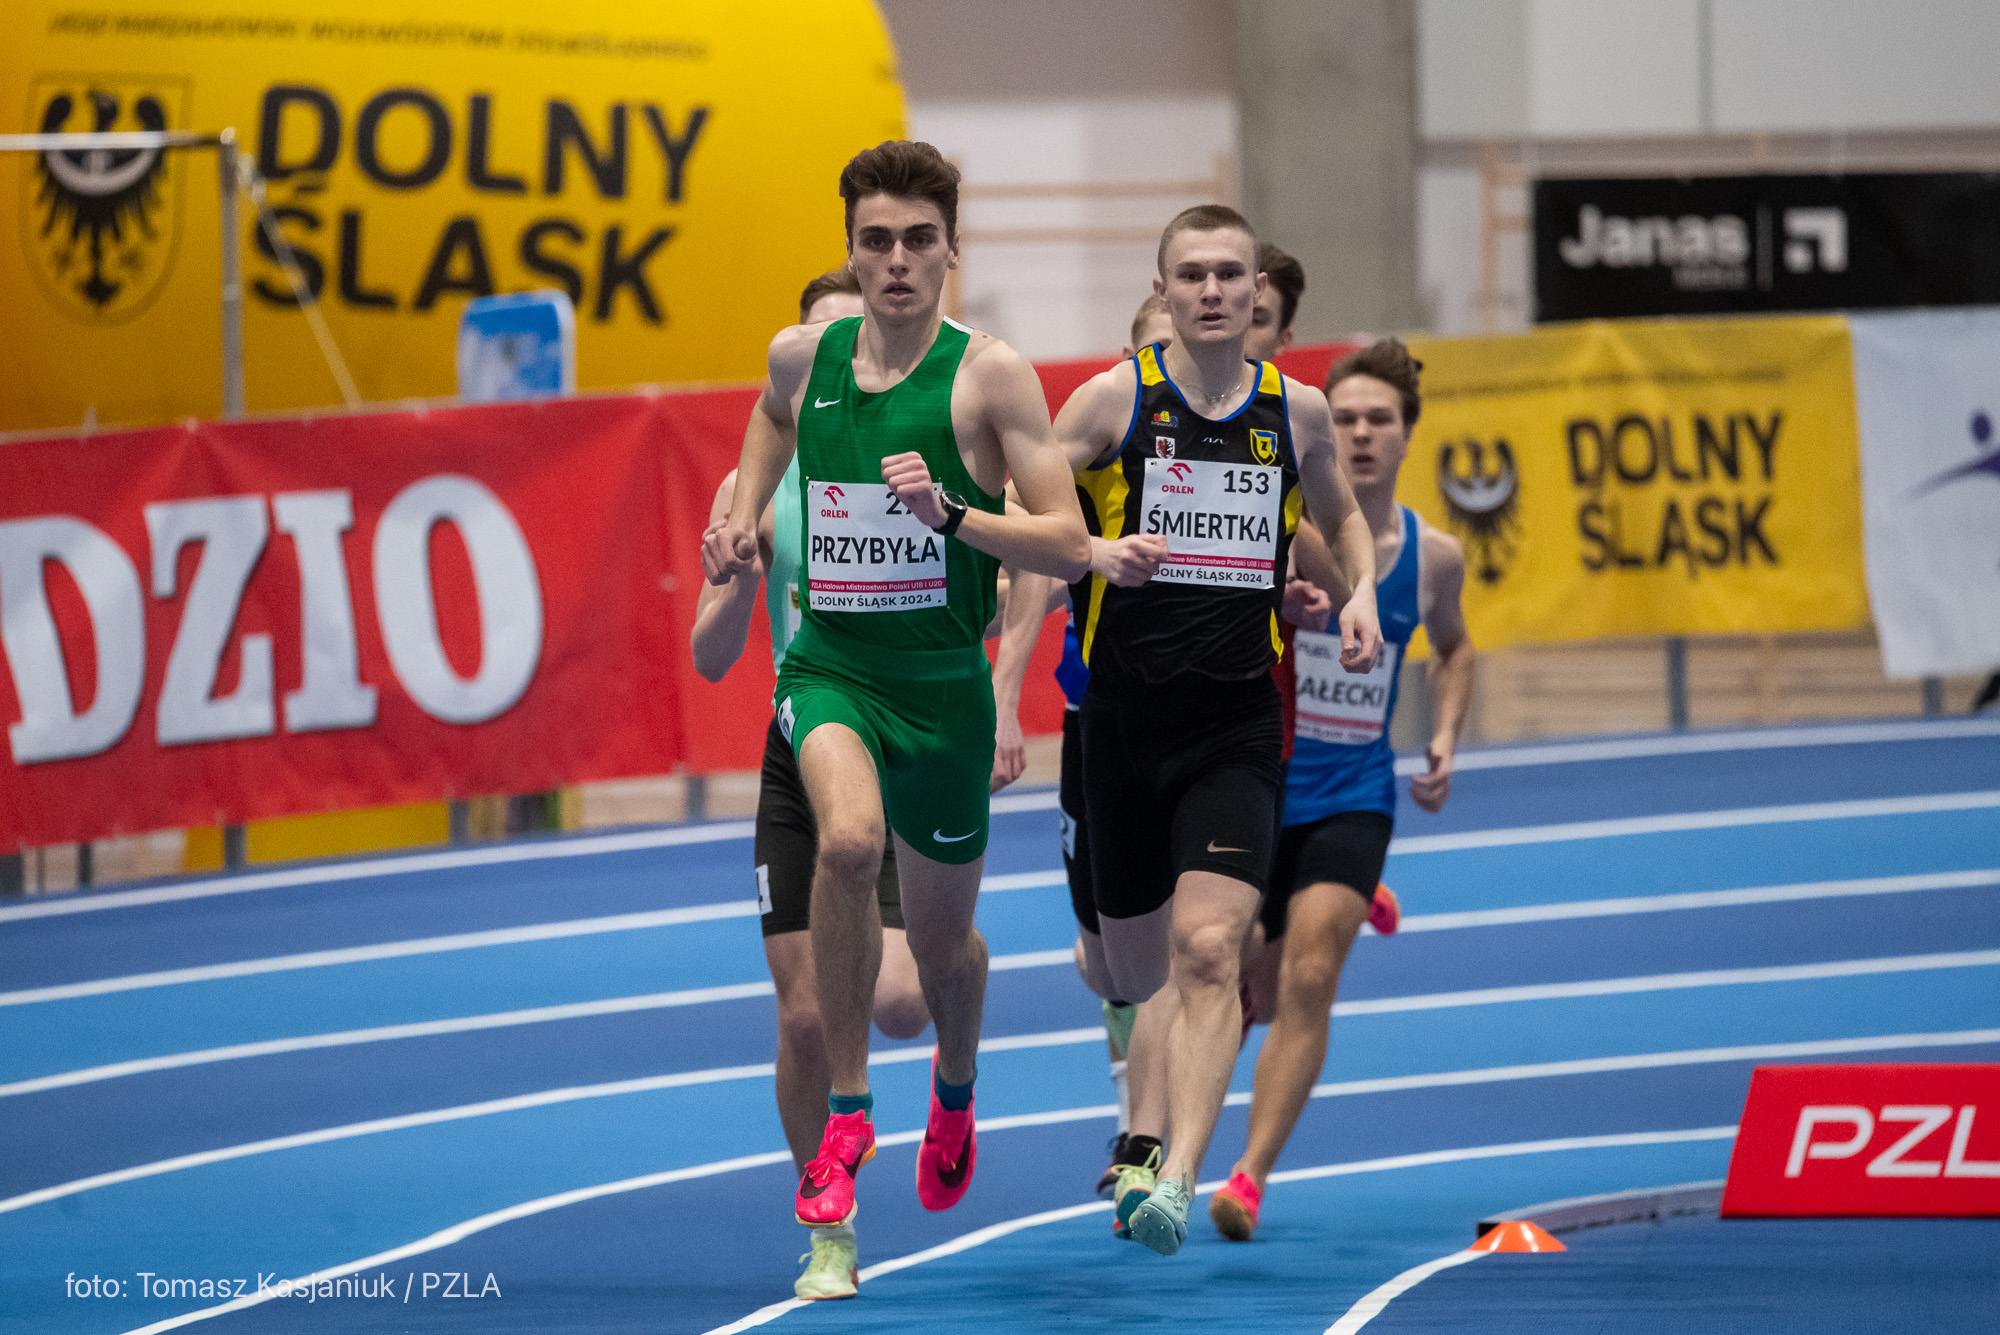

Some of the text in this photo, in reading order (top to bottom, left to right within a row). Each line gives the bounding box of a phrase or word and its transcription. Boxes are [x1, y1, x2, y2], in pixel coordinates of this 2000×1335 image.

[256, 83, 711, 204] DOLNY
[1559, 203, 1750, 268] Janas
[1565, 409, 1784, 486] DOLNY
[1161, 485, 1194, 495] ORLEN
[1223, 470, 1270, 494] 153
[820, 508, 849, 518] ORLEN
[1146, 504, 1271, 543] ŚMIERTKA
[812, 535, 941, 564] PRZYBYŁA
[1227, 559, 1247, 567] Polski
[889, 582, 910, 590] Polski
[1196, 568, 1234, 582] ŚLĄSK
[1236, 573, 1263, 583] 2024
[818, 594, 932, 609] DOLNY ŚLĄSK 2024
[0, 474, 543, 765] DZIO
[1296, 673, 1385, 707] AŁECKI
[1784, 1104, 2000, 1179] PZL
